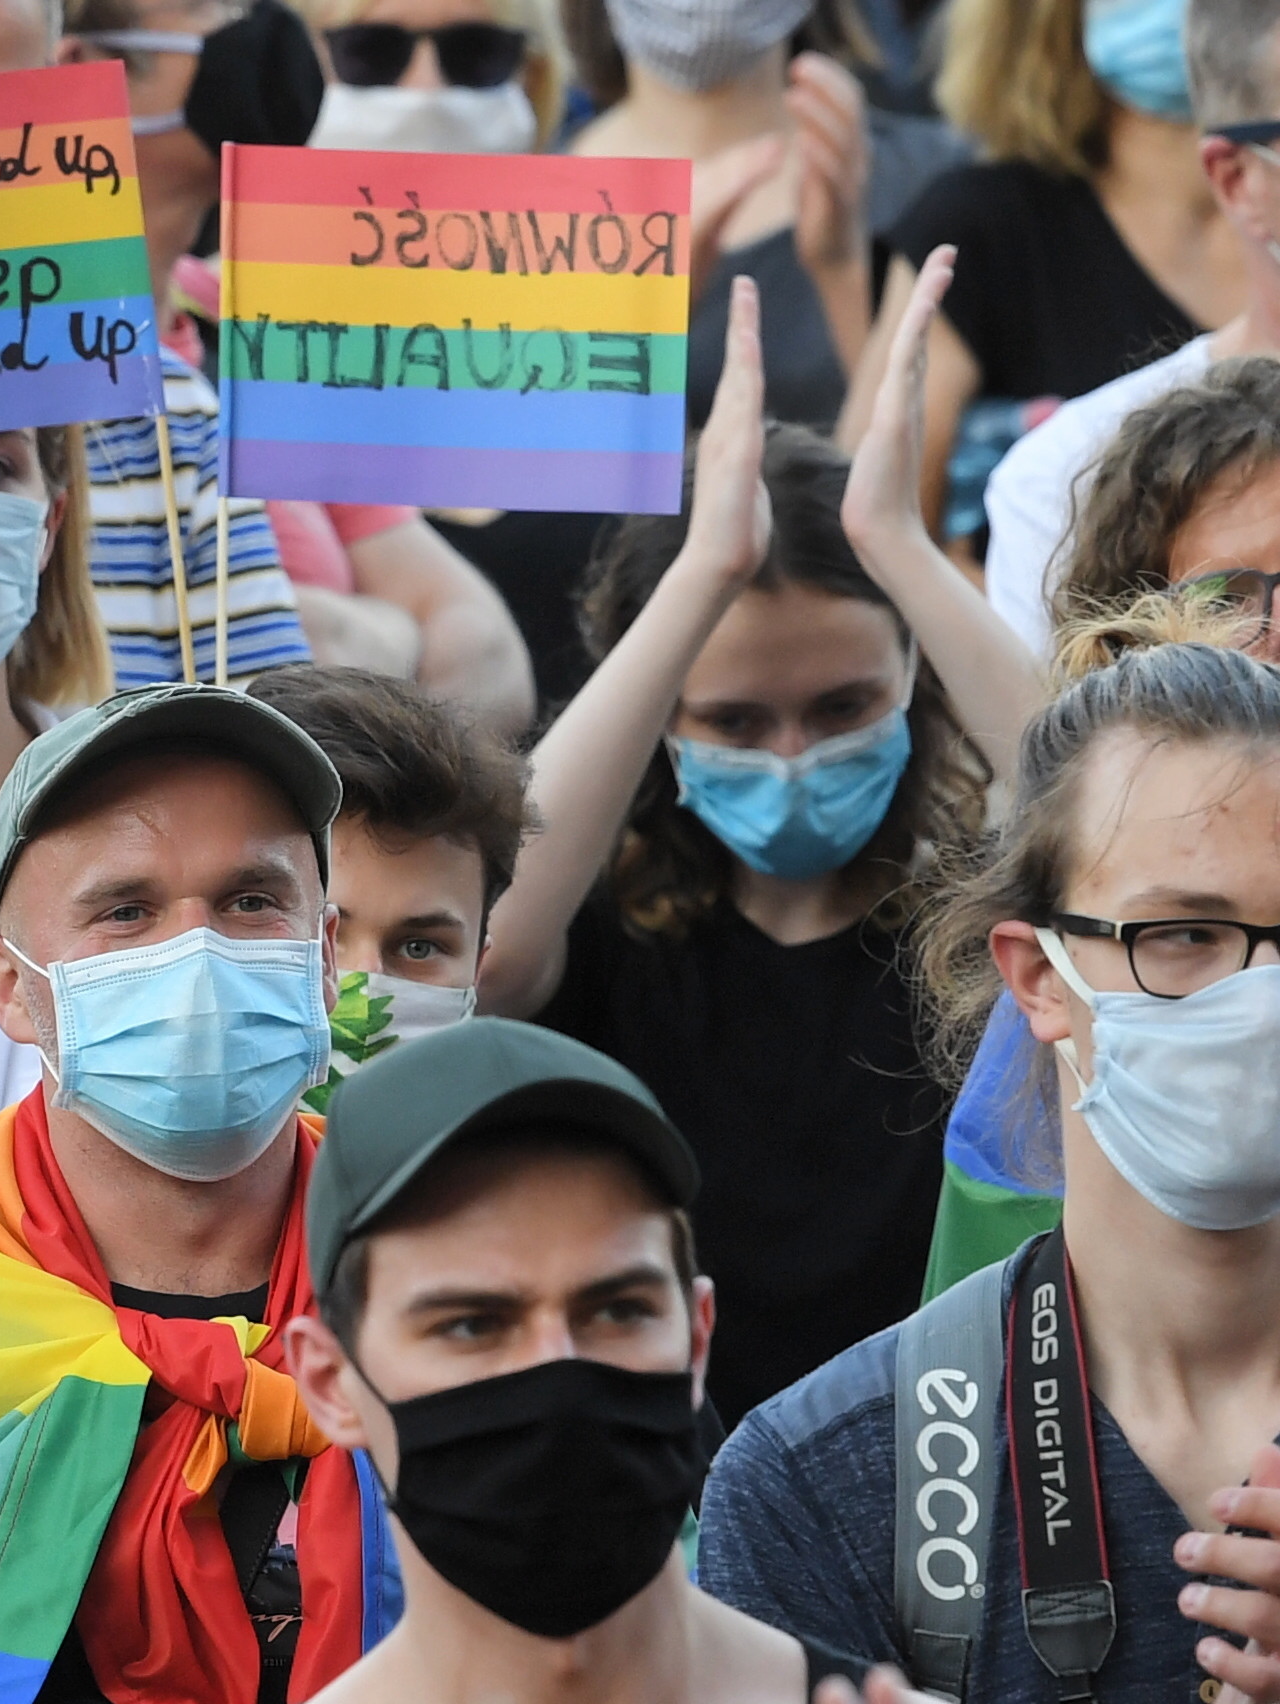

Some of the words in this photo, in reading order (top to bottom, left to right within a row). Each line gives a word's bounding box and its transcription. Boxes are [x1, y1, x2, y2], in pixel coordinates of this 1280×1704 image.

[70, 312, 137, 385] up
[1031, 1282, 1059, 1366] EOS
[916, 1367, 980, 1601] ecco
[1033, 1377, 1072, 1547] DIGITAL
